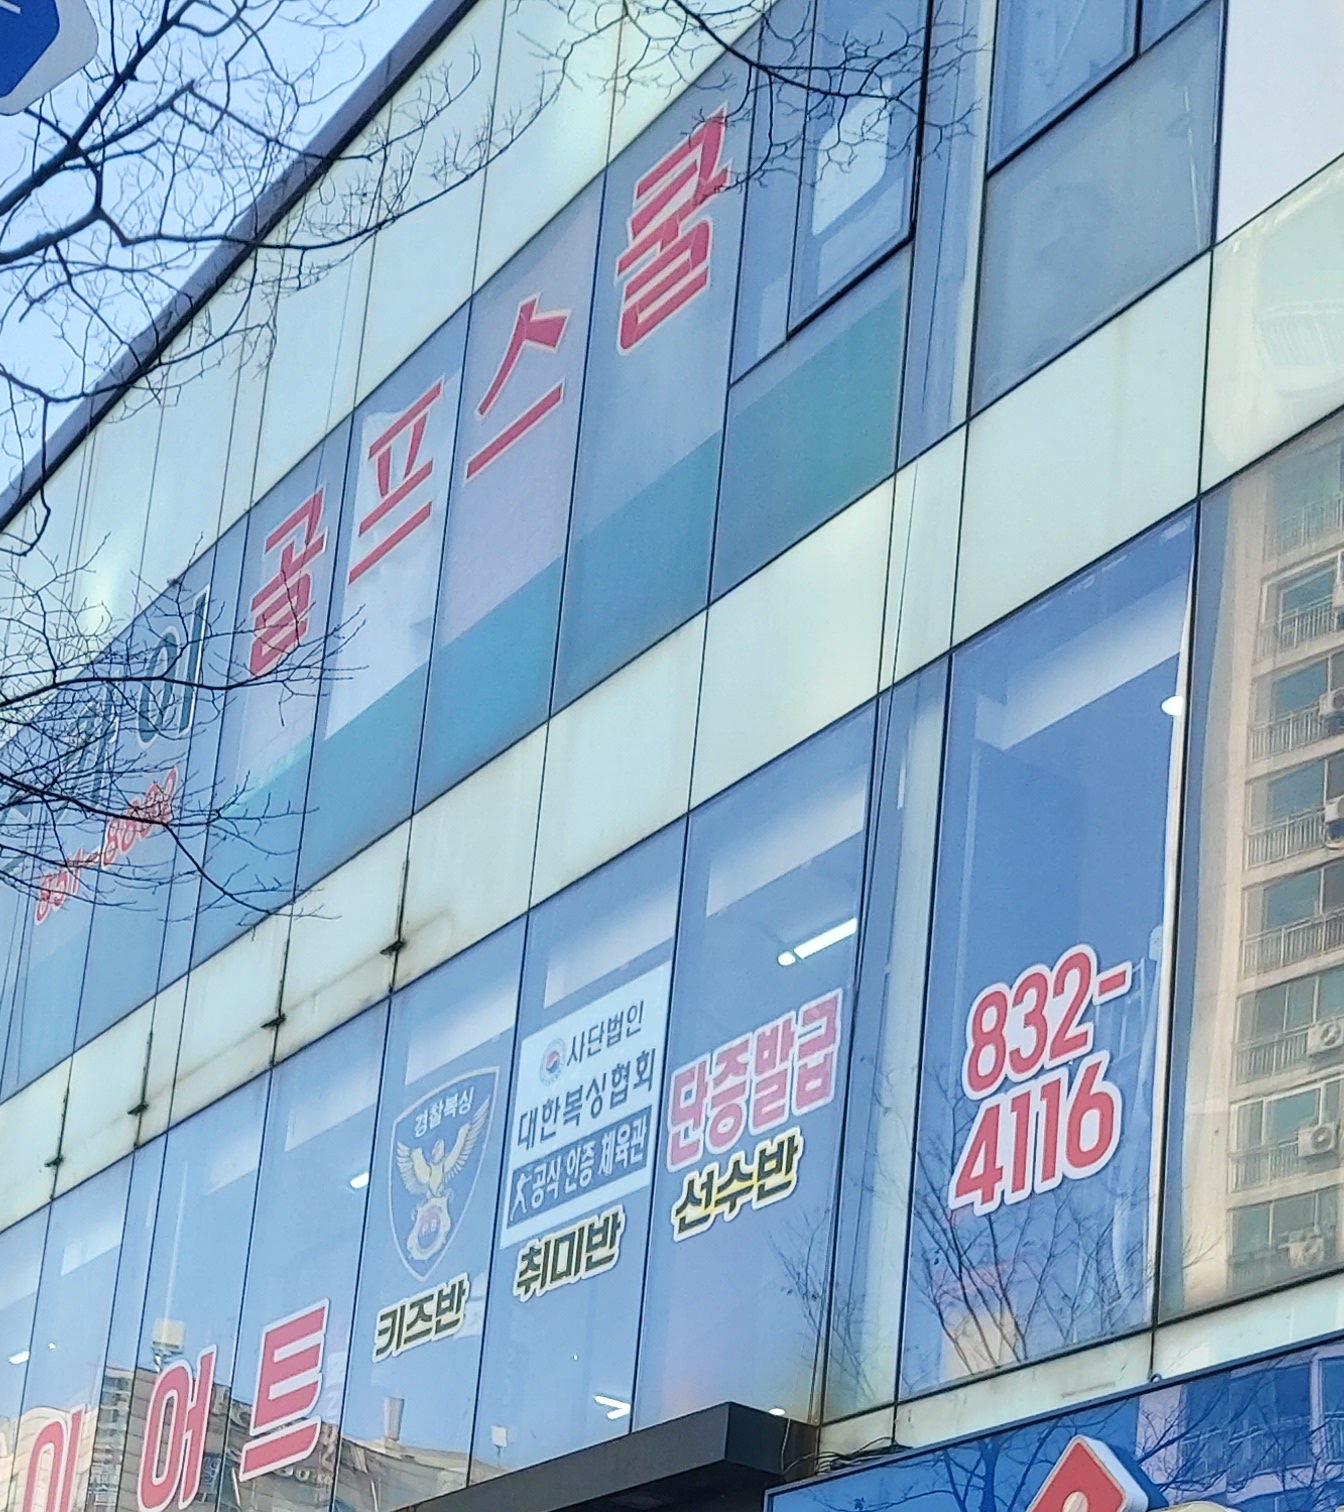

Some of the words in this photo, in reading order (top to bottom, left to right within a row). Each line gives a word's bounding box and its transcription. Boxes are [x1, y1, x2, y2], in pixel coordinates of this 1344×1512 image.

[248, 102, 732, 680] 골프스쿨
[568, 999, 646, 1067] 사단법인
[669, 990, 842, 1170] 단증발급
[415, 1086, 474, 1138] 경찰복싱
[517, 1047, 657, 1150] 대한복싱협회
[952, 1054, 1119, 1211] 4116
[531, 1155, 561, 1209] 공식
[565, 1140, 595, 1193] 인증
[598, 1114, 648, 1177] 체육관
[675, 1130, 801, 1241] 선수반
[516, 1206, 624, 1301] 취미반
[373, 1274, 467, 1362] 키즈반
